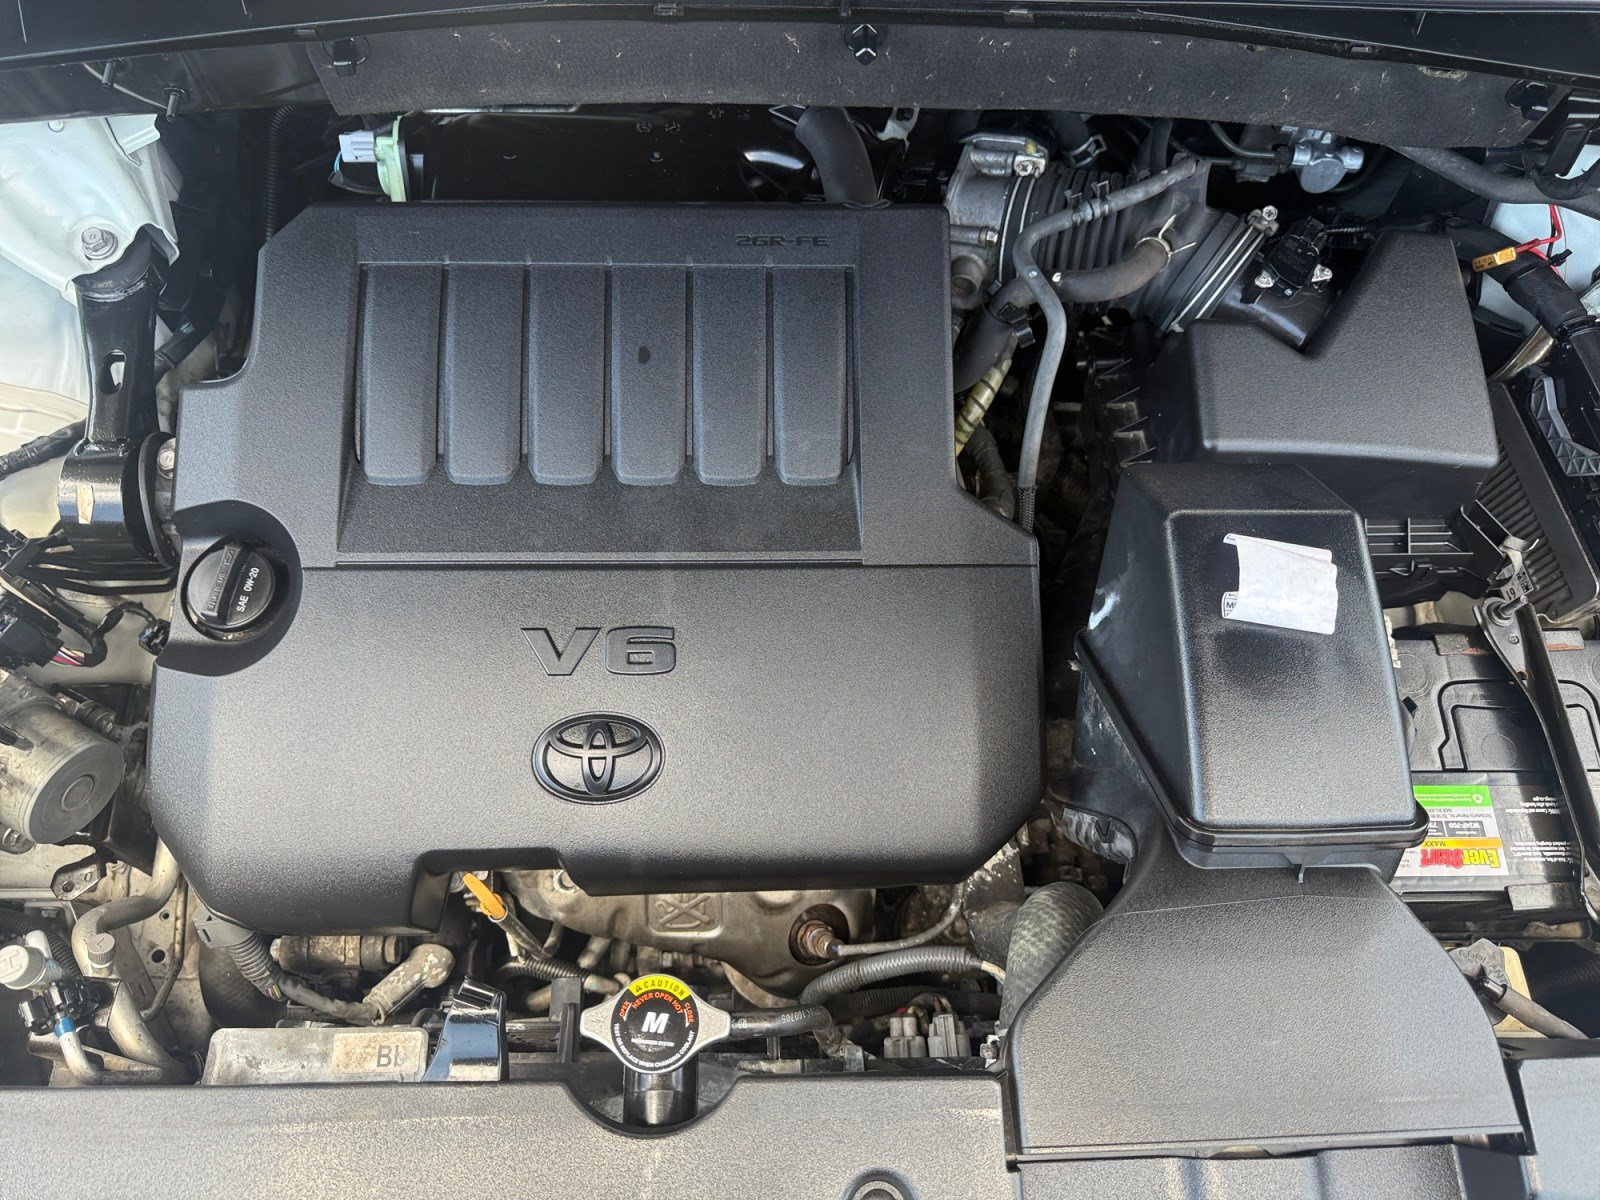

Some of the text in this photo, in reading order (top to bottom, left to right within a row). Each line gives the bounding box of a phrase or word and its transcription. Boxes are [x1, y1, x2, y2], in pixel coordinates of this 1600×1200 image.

[736, 234, 830, 247] 2GR-FE
[236, 567, 260, 613] SAE 0W-20
[520, 625, 677, 677] V6
[1420, 848, 1501, 869] EverStart
[643, 979, 686, 997] CAUTION
[619, 1001, 631, 1017] OPEN
[631, 992, 683, 1014] NEVER OPEN HOT
[684, 1002, 695, 1024] CLOSE
[641, 1011, 670, 1034] M
[619, 1045, 639, 1064] REPLACE
[654, 1053, 681, 1068] CHANGING
[679, 1030, 695, 1055] COOLANT
